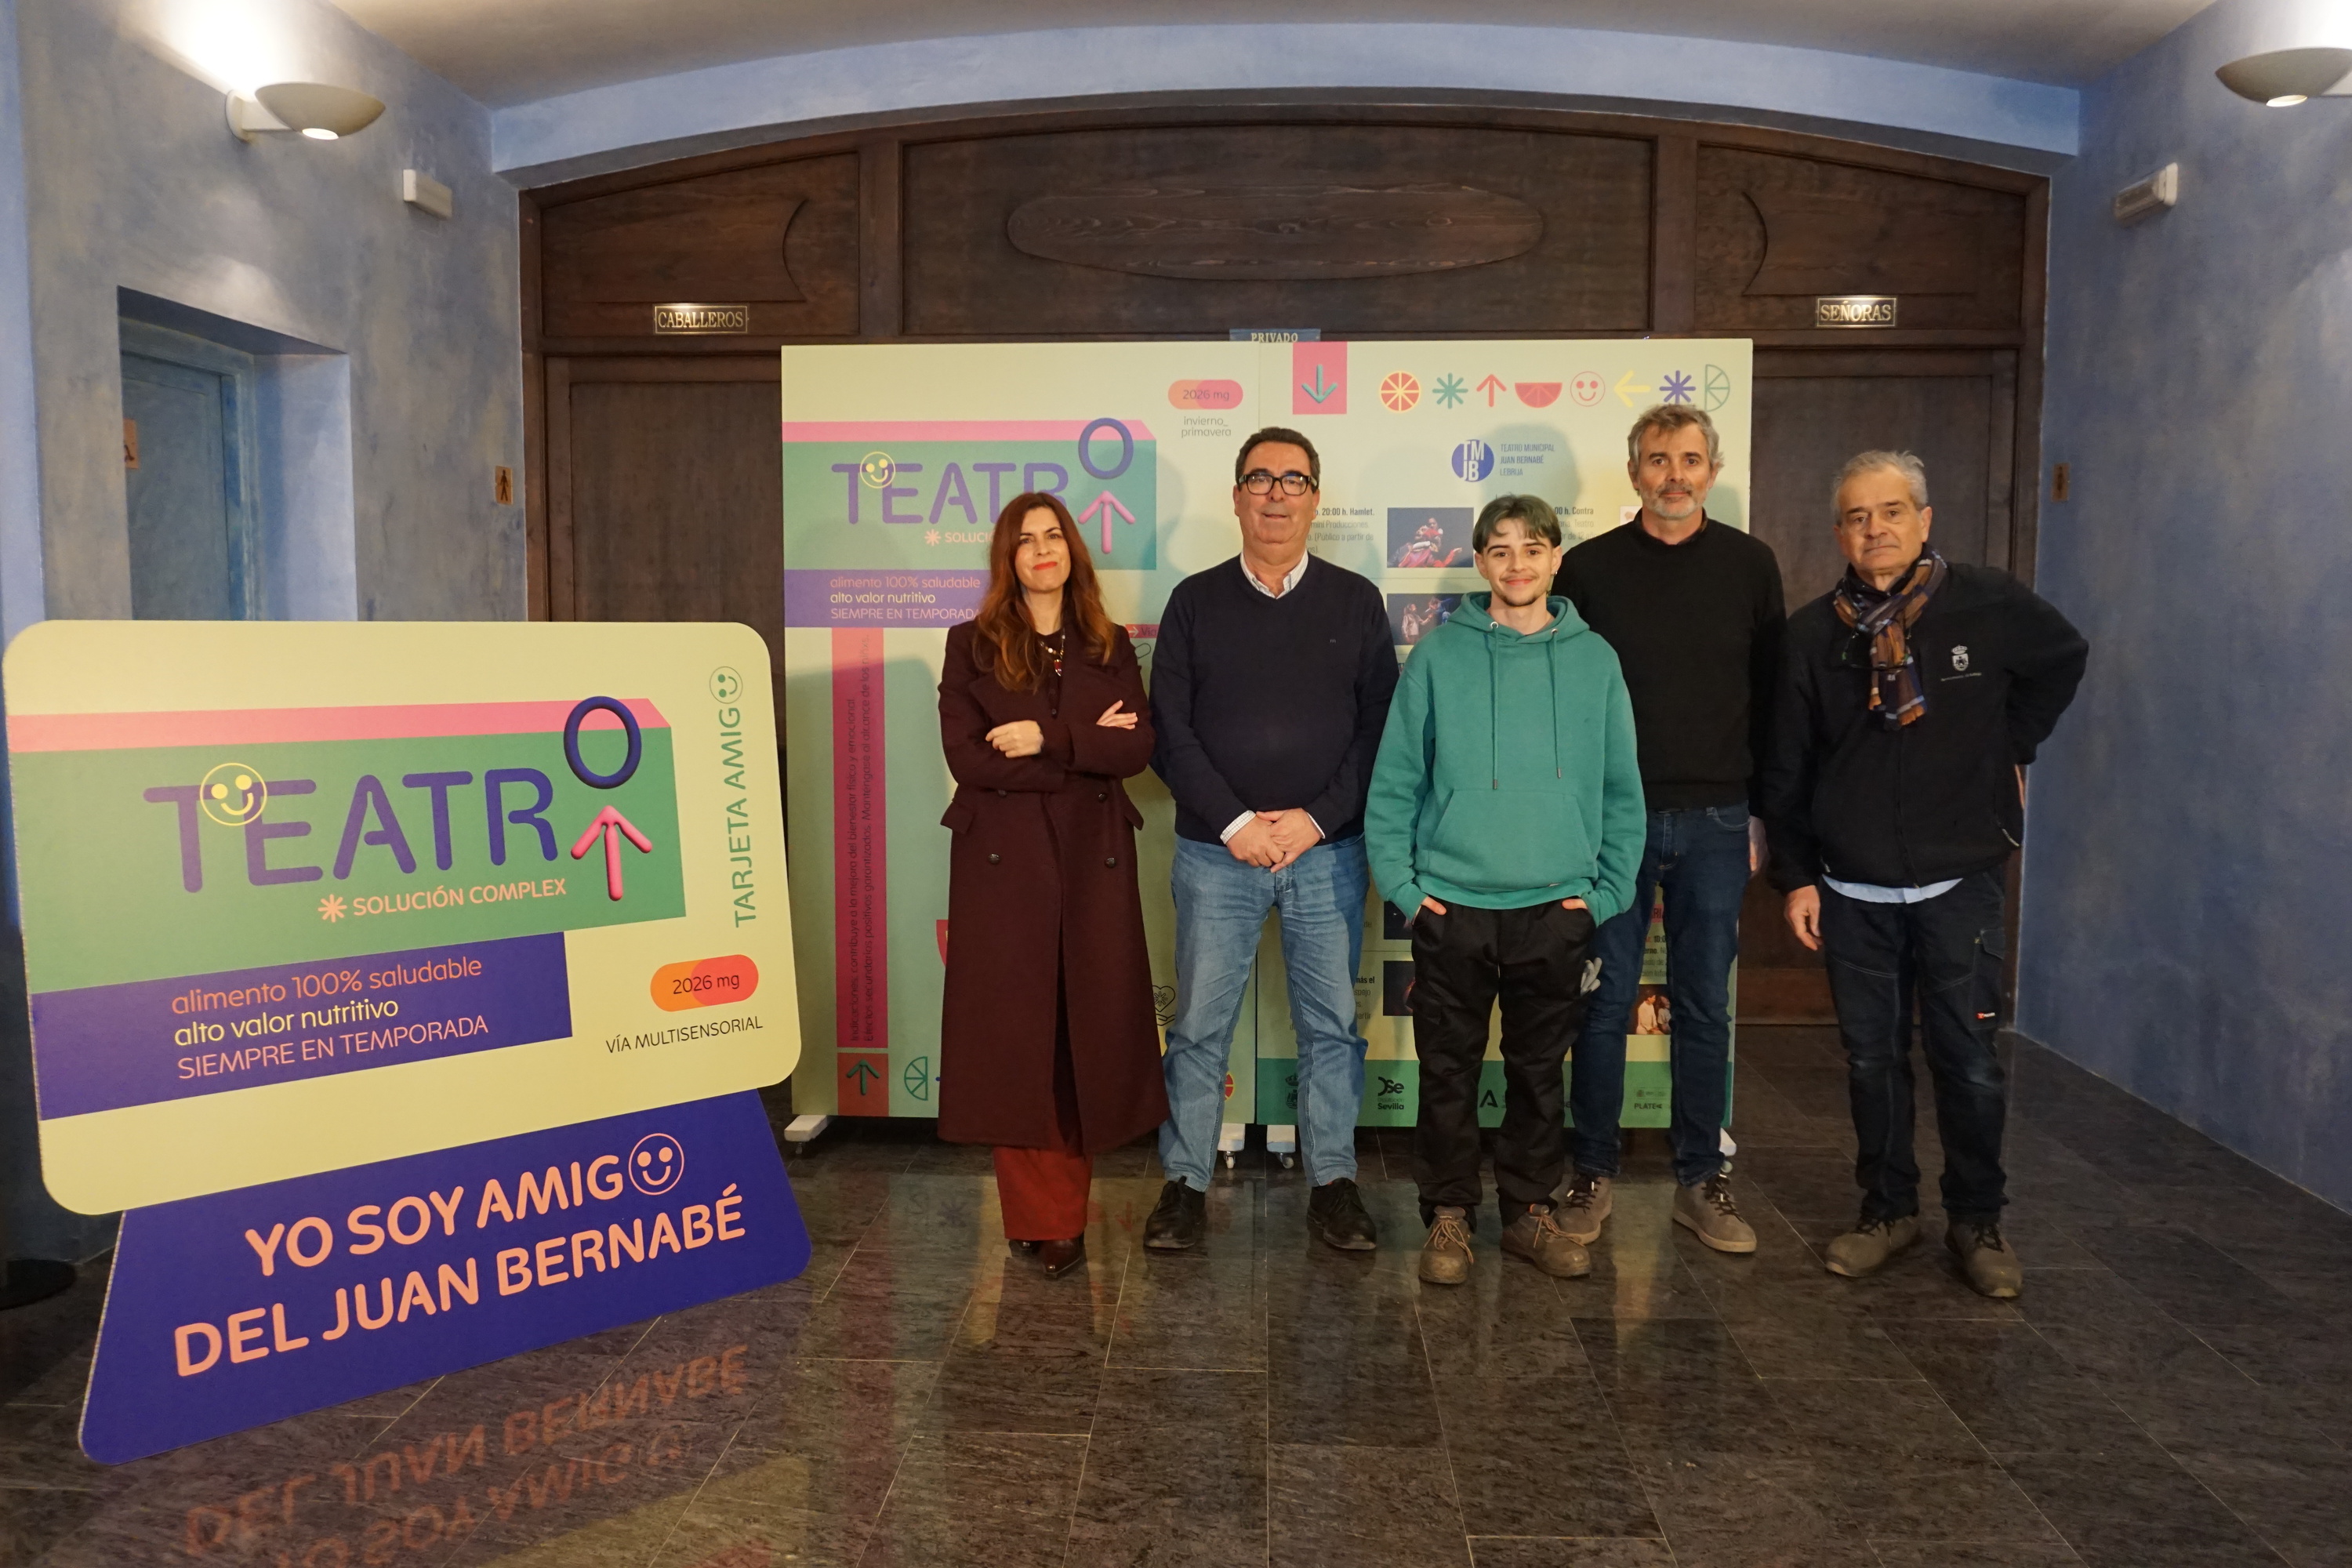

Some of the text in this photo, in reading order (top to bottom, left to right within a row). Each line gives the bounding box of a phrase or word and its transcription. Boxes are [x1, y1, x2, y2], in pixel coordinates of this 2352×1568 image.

[658, 311, 743, 328] CABALLEROS
[1820, 300, 1891, 322] SEÑORAS
[1250, 332, 1298, 343] PRIVADO
[1183, 390, 1229, 401] 2026 mg
[1181, 426, 1232, 438] primavera
[1501, 443, 1555, 452] TEATRO MUNICIPAL
[1516, 455, 1544, 464] BERNABÉ
[1500, 468, 1523, 477] LEBRIJA
[1322, 507, 1340, 516] 20:00
[1350, 507, 1374, 516] Hamlet.
[1572, 506, 1594, 515] Contra
[1574, 519, 1594, 528] Teatro
[1347, 532, 1363, 542] partir
[1366, 532, 1374, 541] de
[829, 575, 981, 588] alimento 100% saludable
[830, 591, 936, 603] alto valor nutritivo
[831, 608, 884, 619] SIEMPRE
[887, 608, 902, 619] EN
[860, 666, 869, 681] los
[861, 684, 869, 698] de
[861, 699, 870, 741] alcance
[861, 743, 870, 753] al
[143, 695, 642, 894] TEATRO
[848, 793, 857, 840] bienestar
[848, 843, 858, 858] del
[726, 797, 757, 928] TARJETA
[848, 861, 858, 896] mejora
[352, 877, 567, 916] SOLUCIÓN COMPLEX
[849, 898, 858, 908] la
[862, 894, 874, 938] positivos
[849, 919, 859, 973] contribuye
[863, 941, 873, 1002] secundarios
[171, 956, 483, 1014] alimento 100% saludable
[673, 975, 739, 994] 2026 mg
[174, 998, 399, 1047] alto valor nutritivo
[864, 1005, 874, 1041] Efectos
[605, 1015, 764, 1054] VÍA MULTISENSORIAL
[177, 1014, 489, 1080] SIEMPRE EN TEMPORADA
[245, 1216, 333, 1276] YO
[347, 1185, 464, 1256] SOY
[174, 1183, 746, 1377] DEL JUAN BERNABÉ
